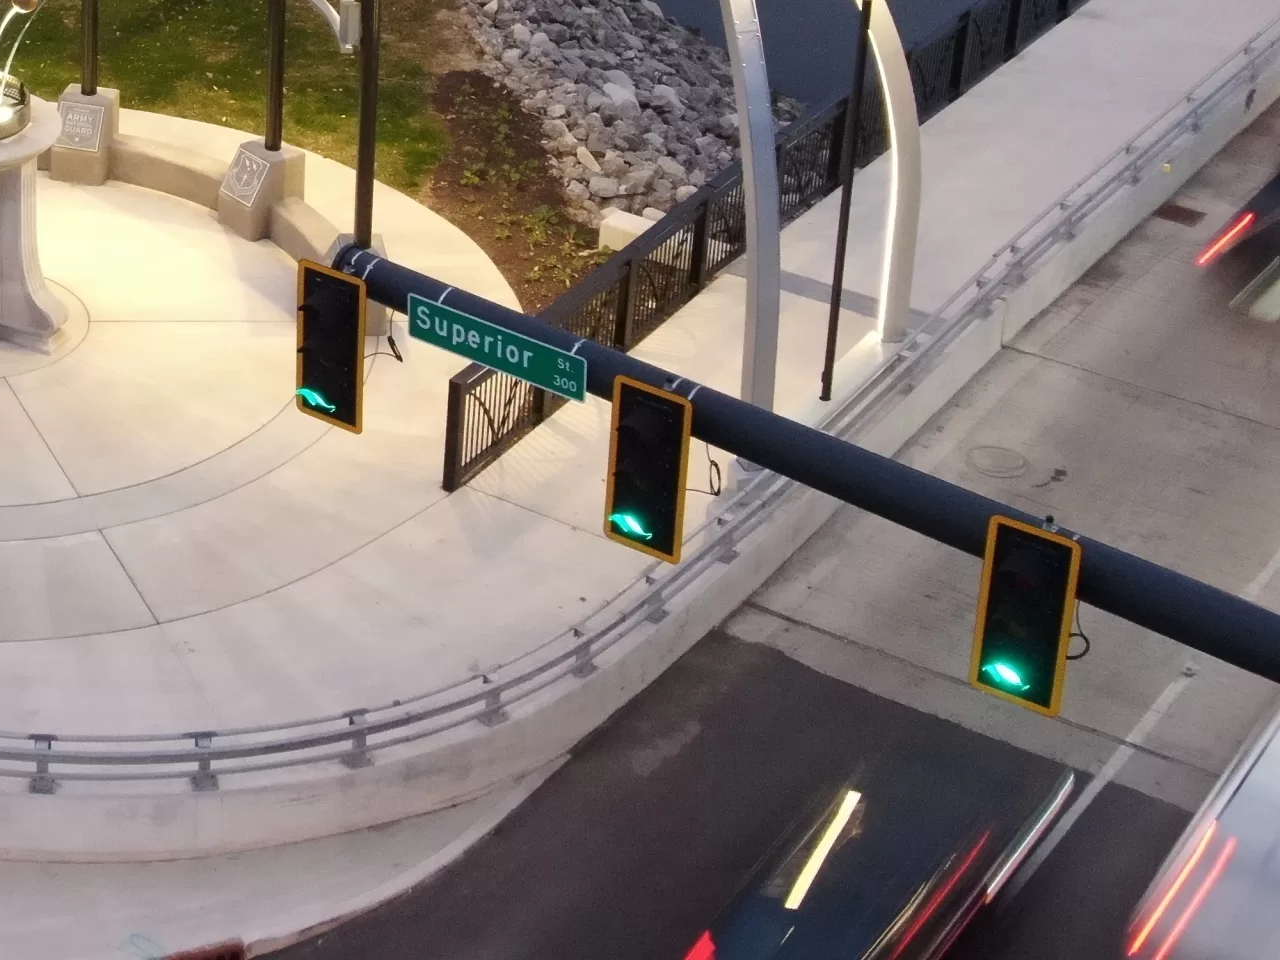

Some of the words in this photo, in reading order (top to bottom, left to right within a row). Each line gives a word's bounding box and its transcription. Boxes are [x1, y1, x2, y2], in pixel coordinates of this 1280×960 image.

[67, 113, 94, 123] ARMY
[64, 125, 93, 135] GUARD
[415, 304, 534, 368] Superior
[556, 357, 574, 373] St.
[552, 374, 577, 393] 300
